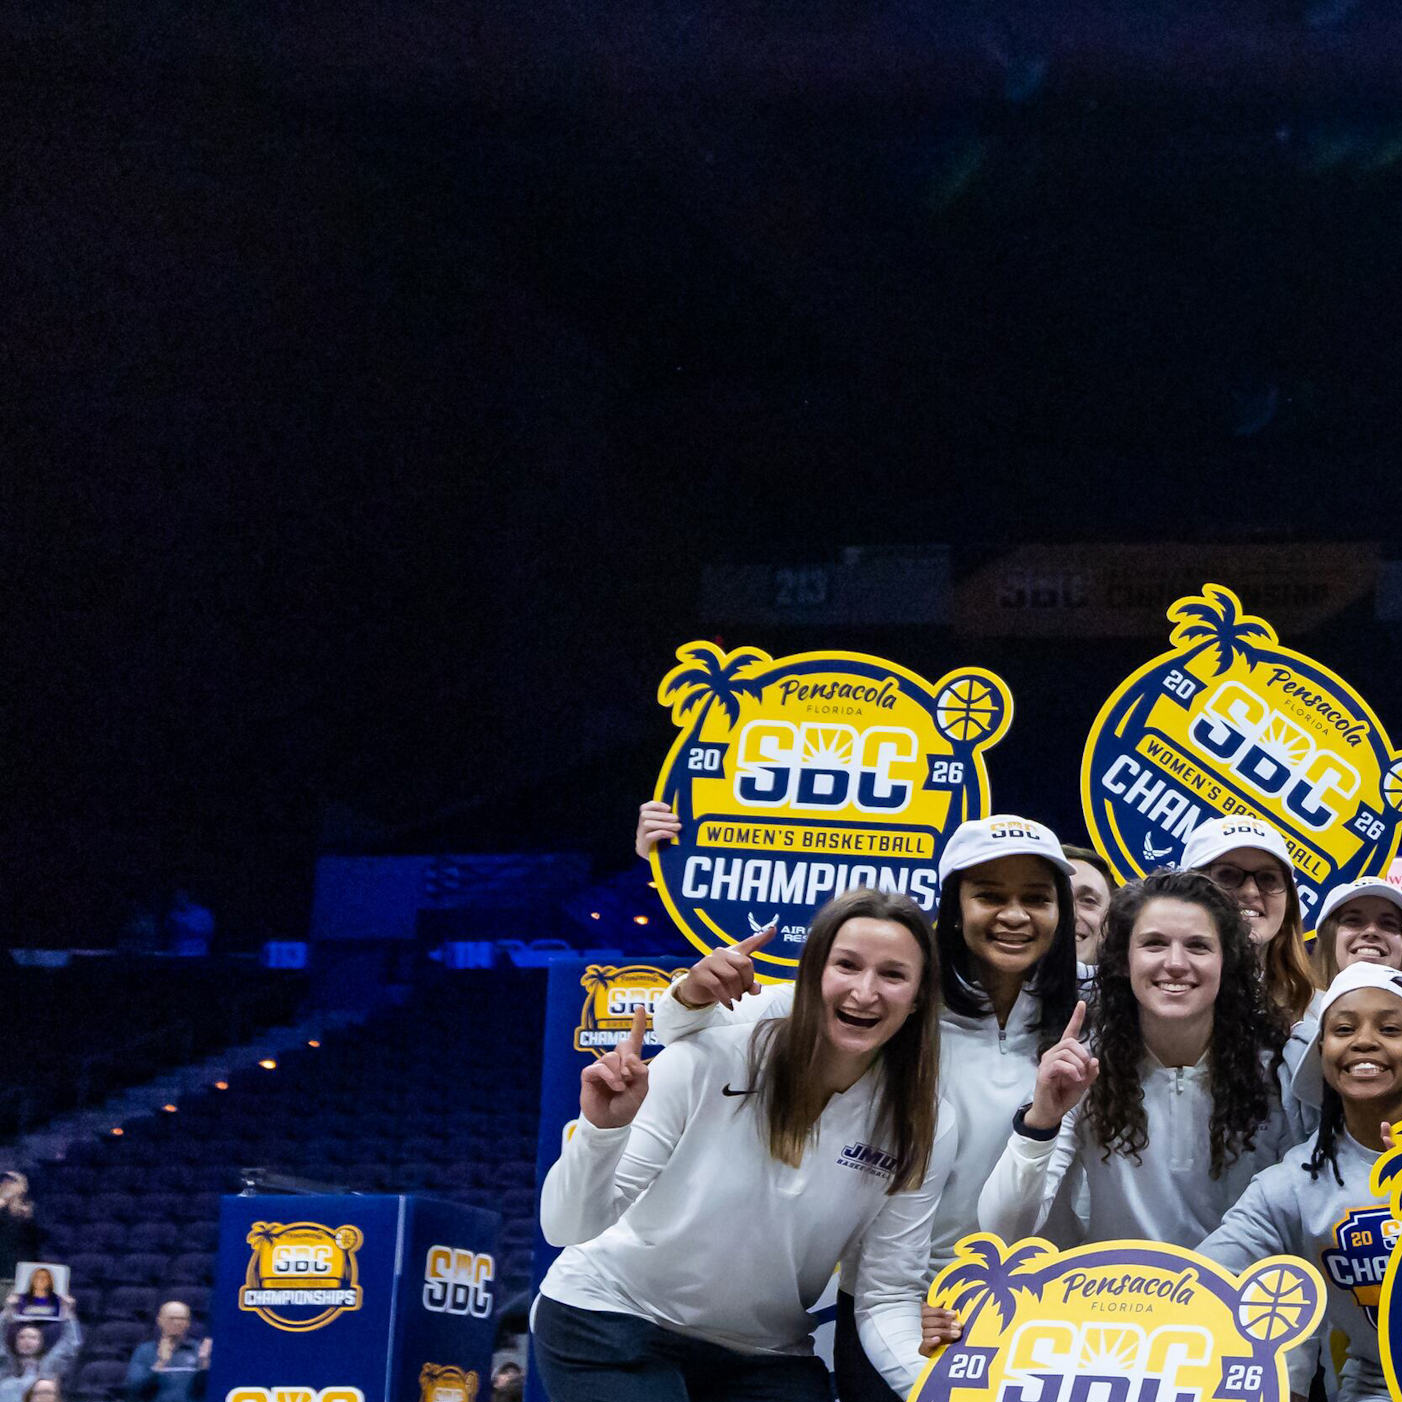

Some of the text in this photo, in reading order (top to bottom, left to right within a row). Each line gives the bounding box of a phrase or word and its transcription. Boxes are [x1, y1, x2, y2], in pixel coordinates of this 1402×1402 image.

[779, 679, 897, 709] Pensacola
[1267, 668, 1365, 747] Pensacola
[688, 720, 963, 814] 20 SBC 26
[1147, 740, 1221, 800] WOMEN'S
[1190, 683, 1385, 840] SBC 26
[707, 827, 924, 853] WOMEN'S BASKETBALL
[991, 821, 1040, 840] SBC
[1351, 1231, 1373, 1247] 20
[272, 1245, 333, 1275] SBC
[423, 1245, 495, 1318] SBC
[1063, 1273, 1195, 1305] Pensacola
[244, 1290, 356, 1306] CHAMPIONSHIPS
[1091, 1302, 1153, 1313] FLORIDA
[949, 1354, 986, 1378] 20
[1225, 1365, 1262, 1390] 26
